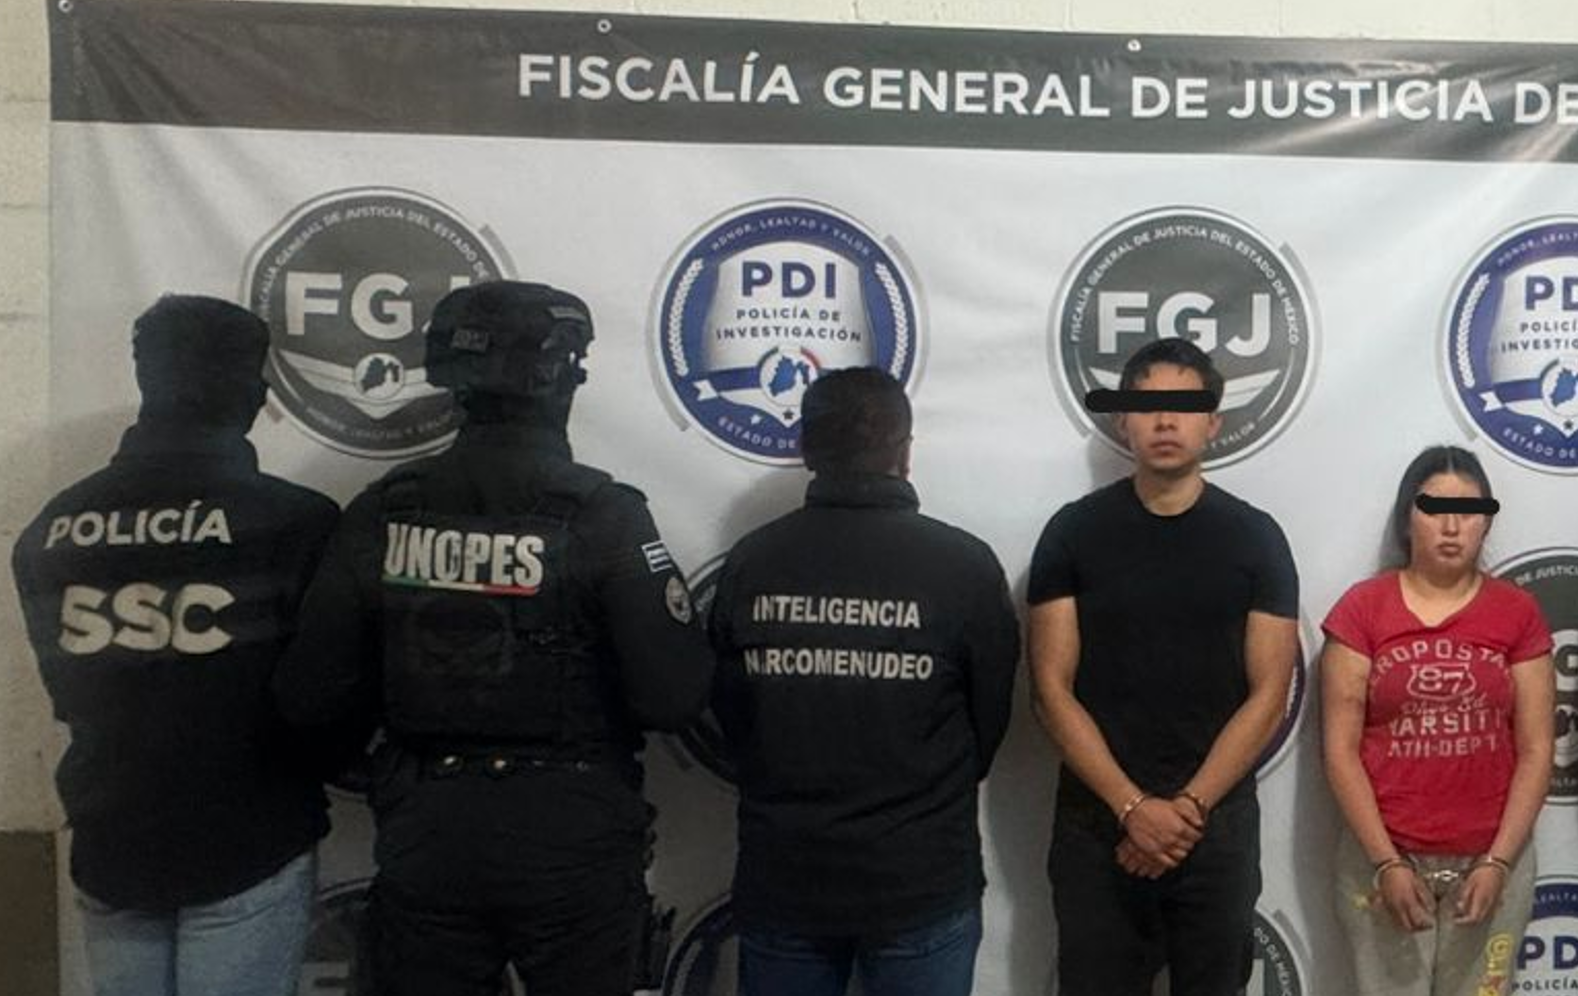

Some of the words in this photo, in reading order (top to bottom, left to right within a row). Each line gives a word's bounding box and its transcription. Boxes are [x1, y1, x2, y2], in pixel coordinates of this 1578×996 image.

[519, 51, 800, 105] FISCALÍA
[823, 67, 1110, 117] GENERAL
[1131, 76, 1208, 119] DE
[1227, 78, 1494, 123] JUSTICIA
[346, 206, 404, 219] JUSTICIA
[1087, 242, 1136, 287] GENERAL
[1133, 230, 1151, 247] DE
[1153, 225, 1207, 241] JUSTICIA
[1210, 230, 1234, 248] DEL
[1235, 240, 1276, 281] ESTADO
[1271, 278, 1285, 297] DE
[741, 261, 836, 299] PDI
[736, 305, 810, 321] POLICÍA
[819, 309, 841, 322] DE
[1098, 291, 1272, 357] FGJ
[716, 325, 862, 342] INVESTIGACIÓN
[716, 416, 772, 447] ESTADO
[777, 439, 796, 449] DE
[1503, 427, 1554, 457] ESTADO
[1558, 448, 1576, 459] DE
[45, 500, 232, 548] POLICÍA
[383, 522, 544, 588] UNOPES
[58, 582, 235, 655] SSC
[752, 595, 921, 628] INTELIGENCIA
[745, 648, 934, 680] NRCOMENUDEO
[1418, 667, 1465, 694] 87
